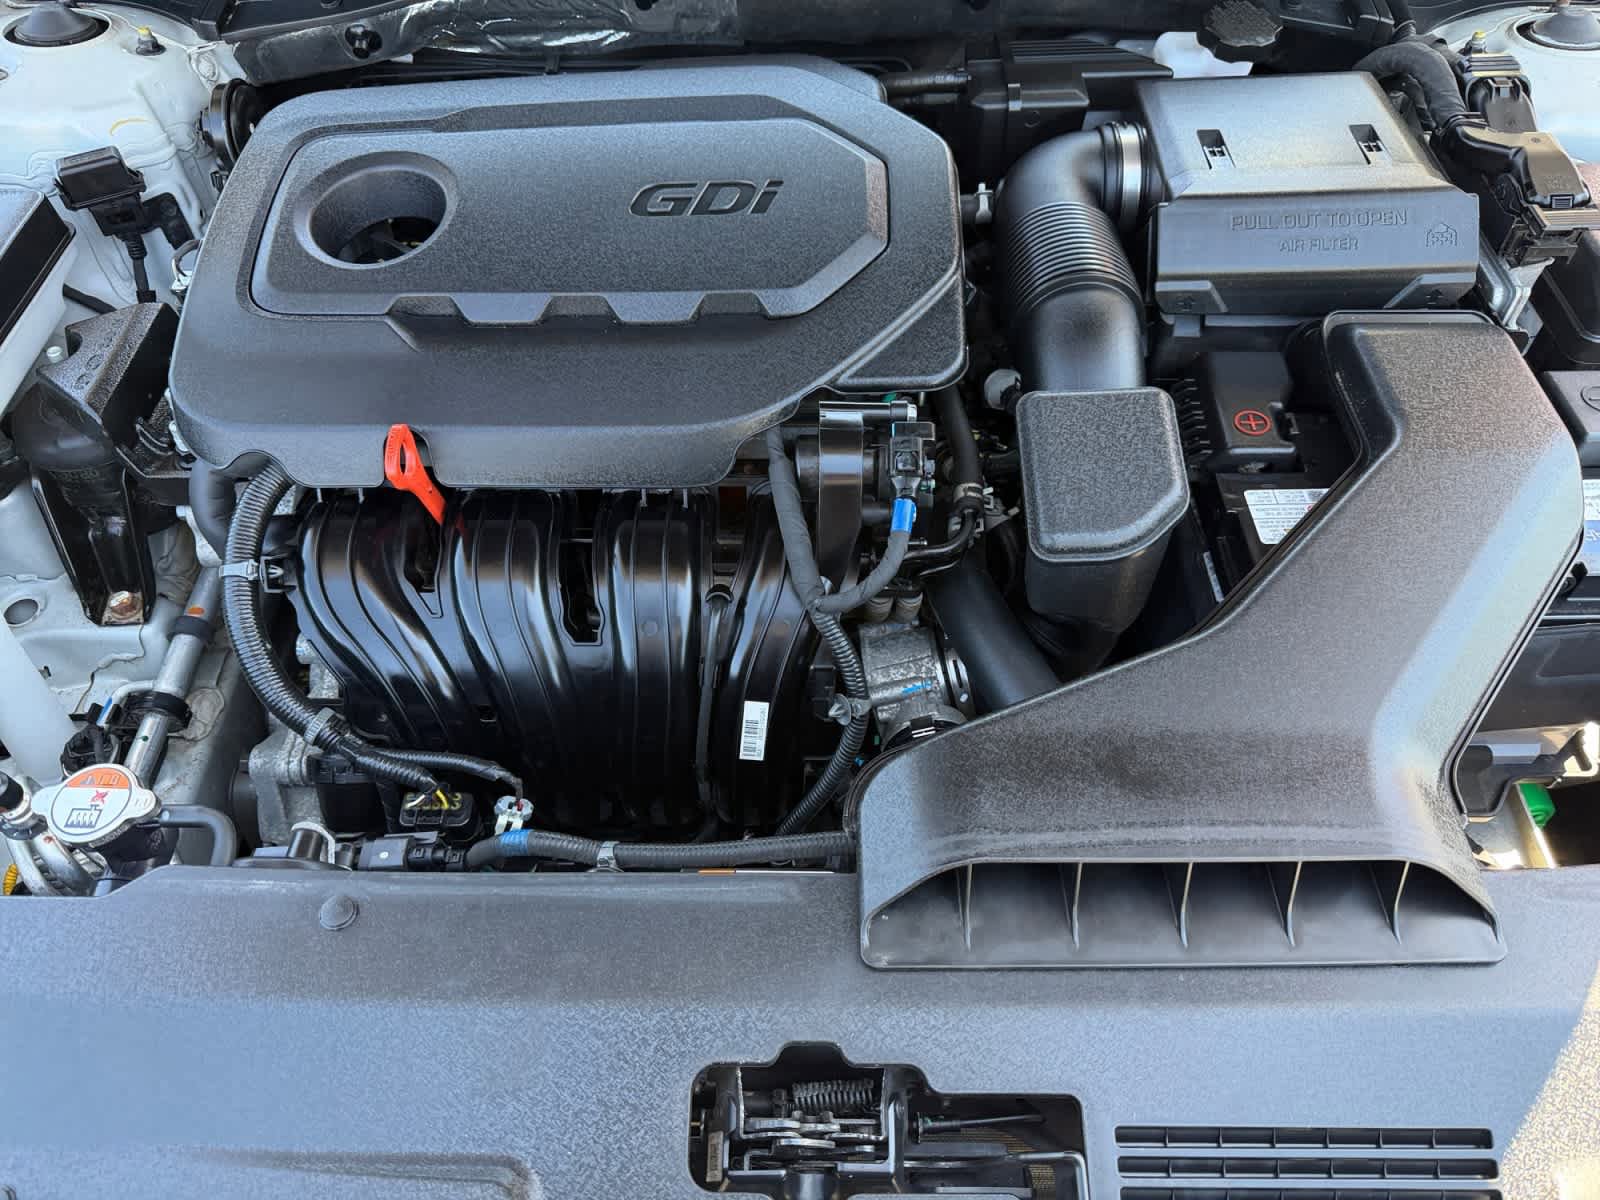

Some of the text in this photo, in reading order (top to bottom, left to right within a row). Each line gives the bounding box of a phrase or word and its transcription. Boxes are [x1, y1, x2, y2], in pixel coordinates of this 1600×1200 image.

[628, 179, 784, 216] GDi
[1232, 209, 1408, 230] PULL OUT TO OPEN
[1280, 238, 1359, 252] AIR FILTER
